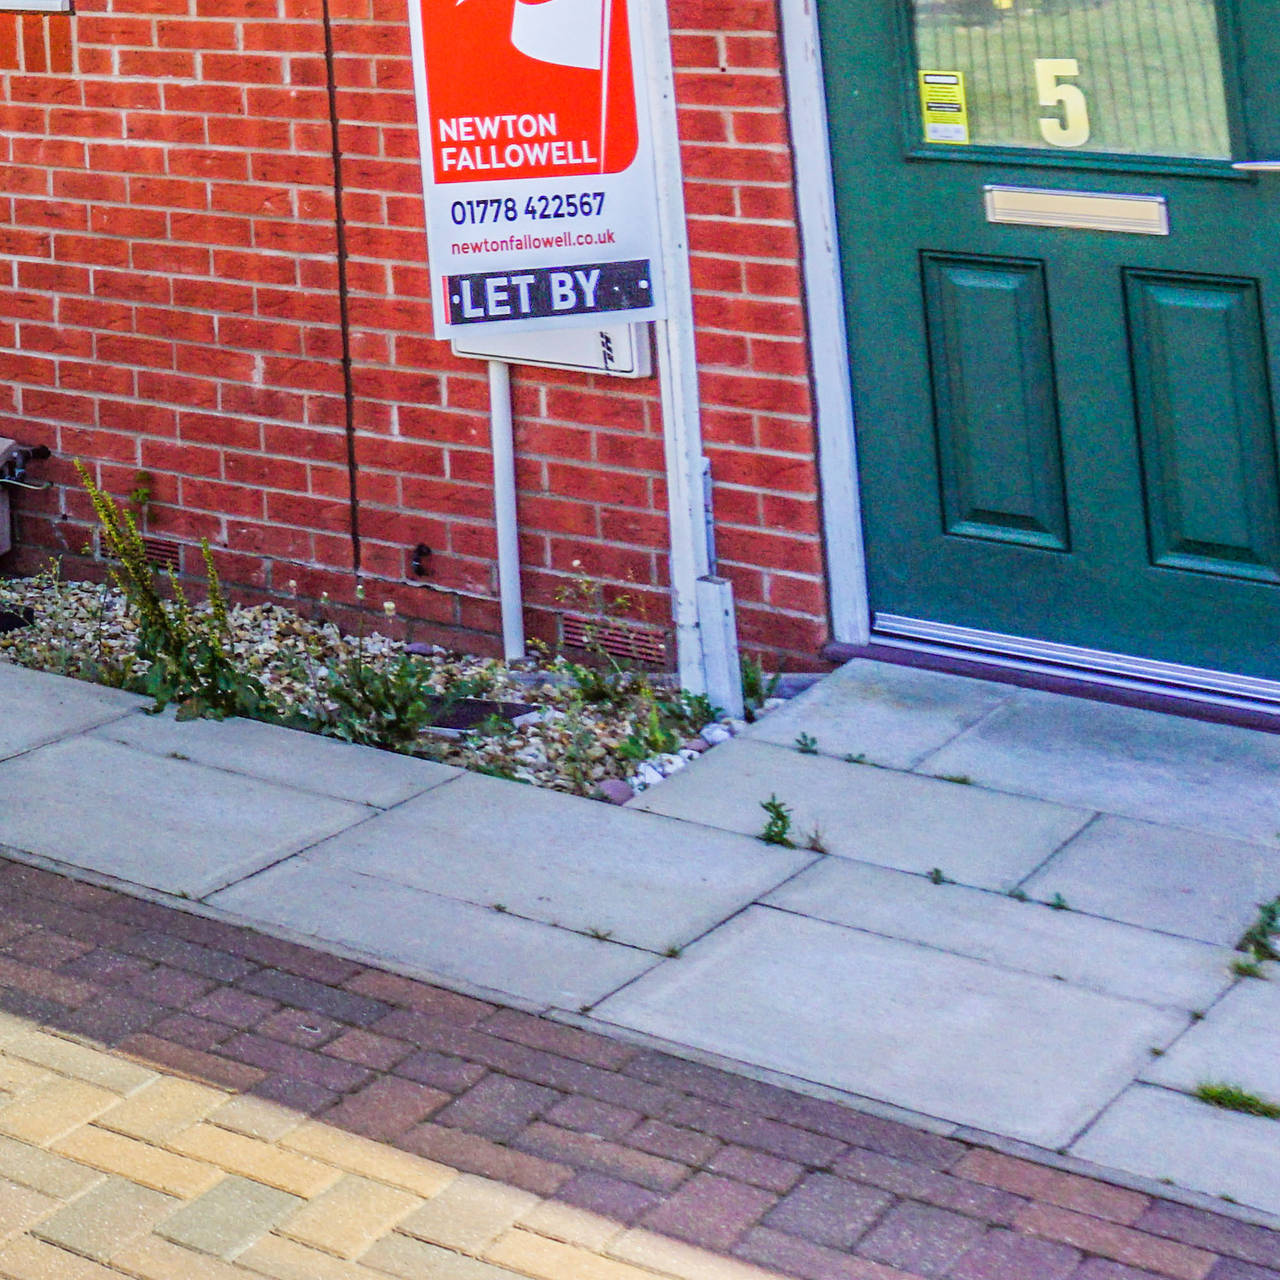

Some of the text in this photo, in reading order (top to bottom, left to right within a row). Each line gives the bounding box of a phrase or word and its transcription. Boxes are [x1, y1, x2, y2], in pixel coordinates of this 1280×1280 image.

[1033, 58, 1090, 147] 5
[439, 113, 557, 142] NEWTON
[441, 140, 597, 171] FALLOWELL
[451, 191, 605, 225] 01778 422567
[451, 228, 616, 255] newtonfallowell.co.uk
[461, 269, 601, 318] LET BY
